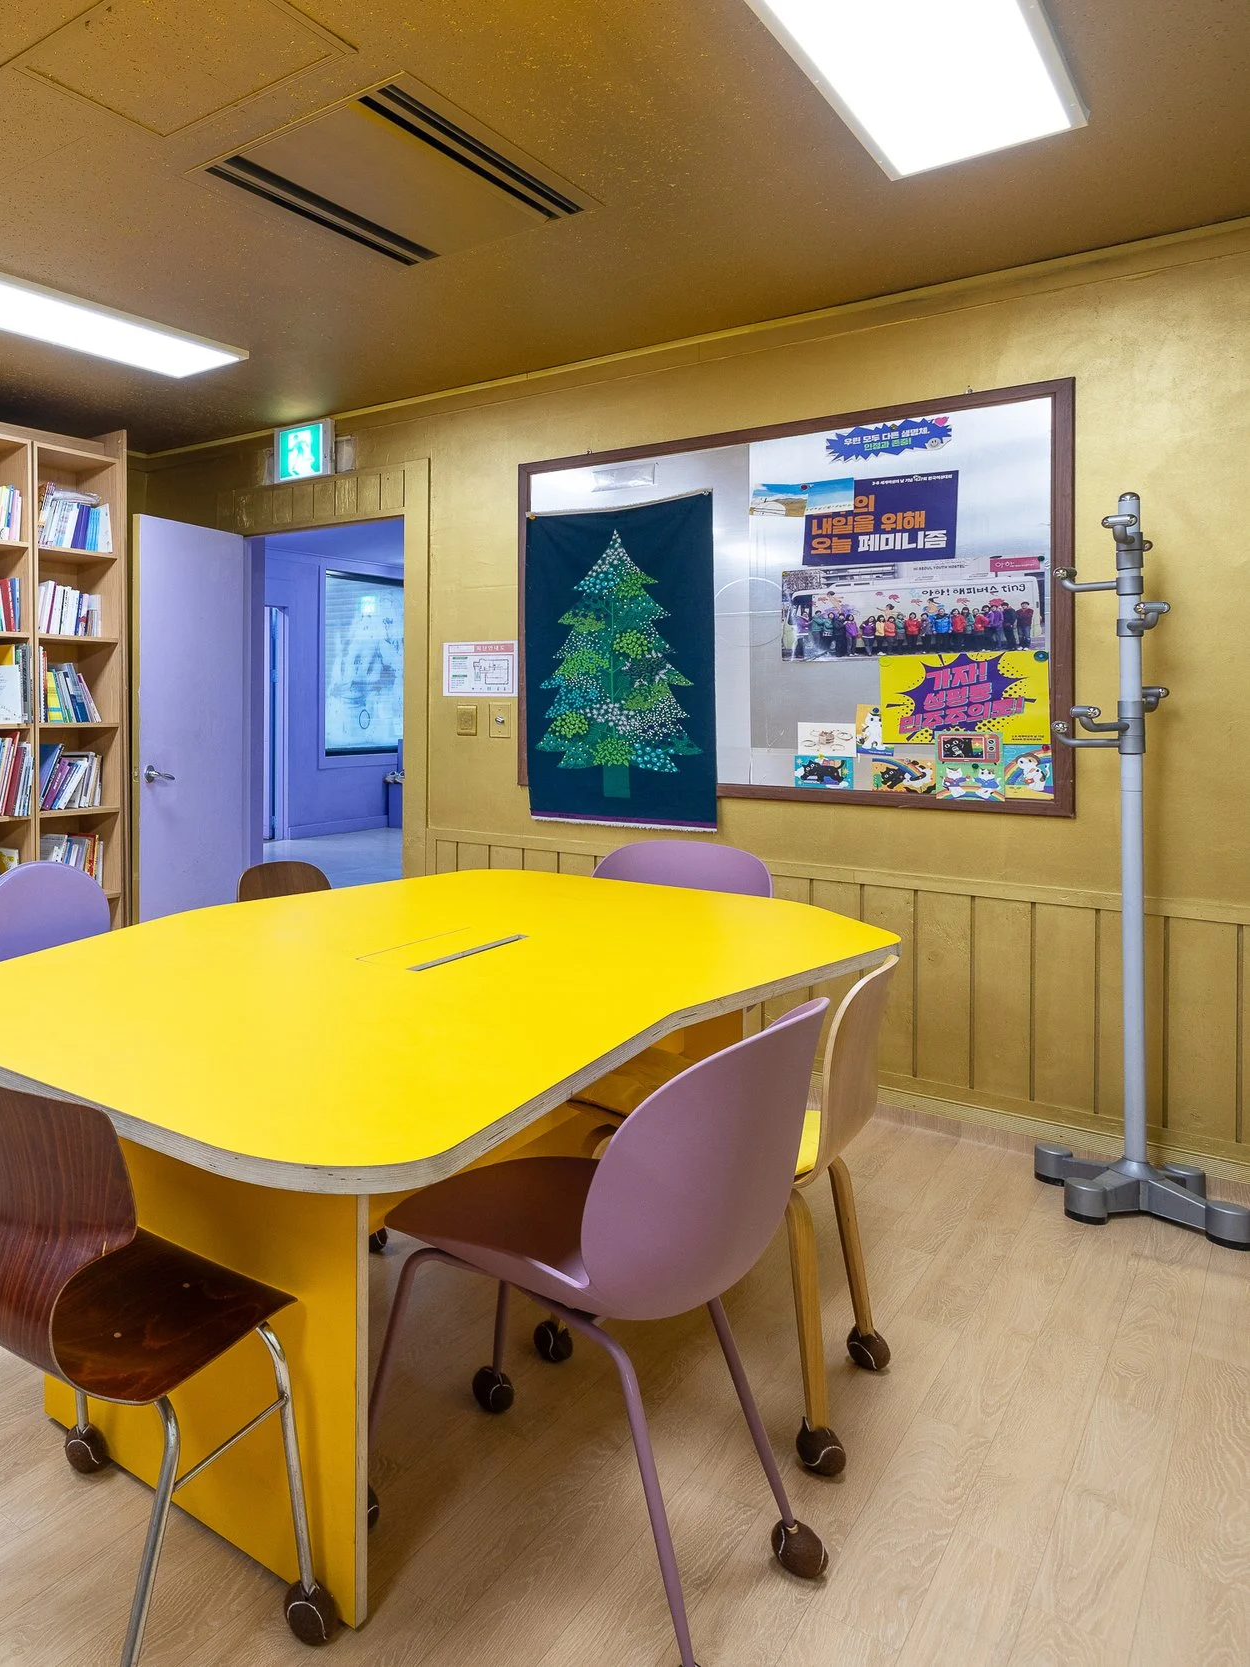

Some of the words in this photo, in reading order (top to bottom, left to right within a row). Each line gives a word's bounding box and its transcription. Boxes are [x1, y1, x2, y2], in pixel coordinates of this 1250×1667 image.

[843, 436, 861, 445] 우린
[862, 434, 880, 443] 모두
[881, 431, 899, 441] 다른
[863, 440, 890, 451] 인정과
[891, 437, 912, 448] 존중!
[811, 514, 875, 535] 내일을
[880, 510, 926, 531] 위해
[810, 536, 852, 555] 오늘
[857, 529, 947, 552] 페미니즘
[921, 588, 950, 597] 아하!
[952, 585, 999, 595] 해피버스
[1001, 583, 1026, 593] ting
[926, 661, 988, 690] 가자!
[923, 682, 993, 711] 성평등
[898, 696, 1025, 735] 민주주의로!
